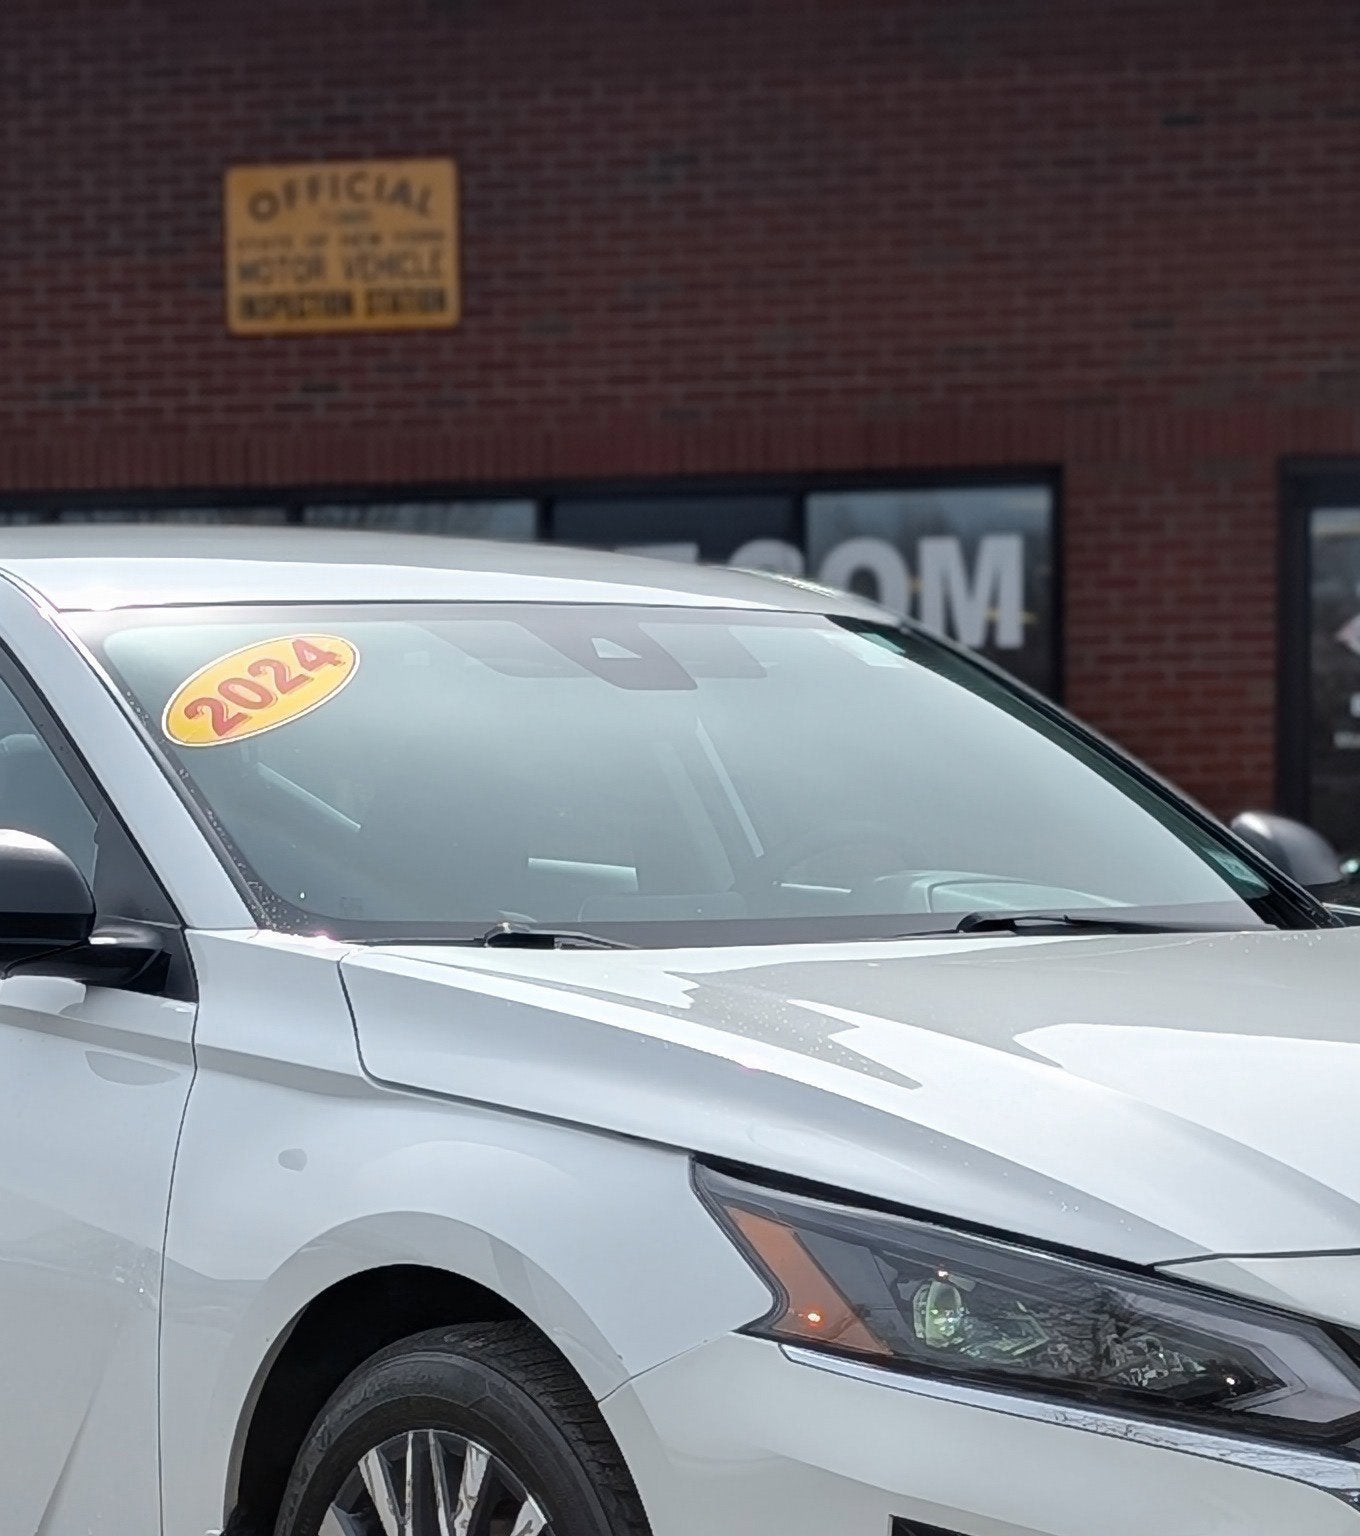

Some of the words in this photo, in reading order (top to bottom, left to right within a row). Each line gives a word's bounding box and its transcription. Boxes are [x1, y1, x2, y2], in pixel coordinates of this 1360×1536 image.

[248, 170, 432, 222] OFFICIAL
[239, 252, 324, 285] MOTOR
[343, 248, 442, 281] VEHICLE
[239, 290, 353, 320] INSPECTION
[365, 286, 447, 316] STATION
[184, 638, 346, 737] 2024
